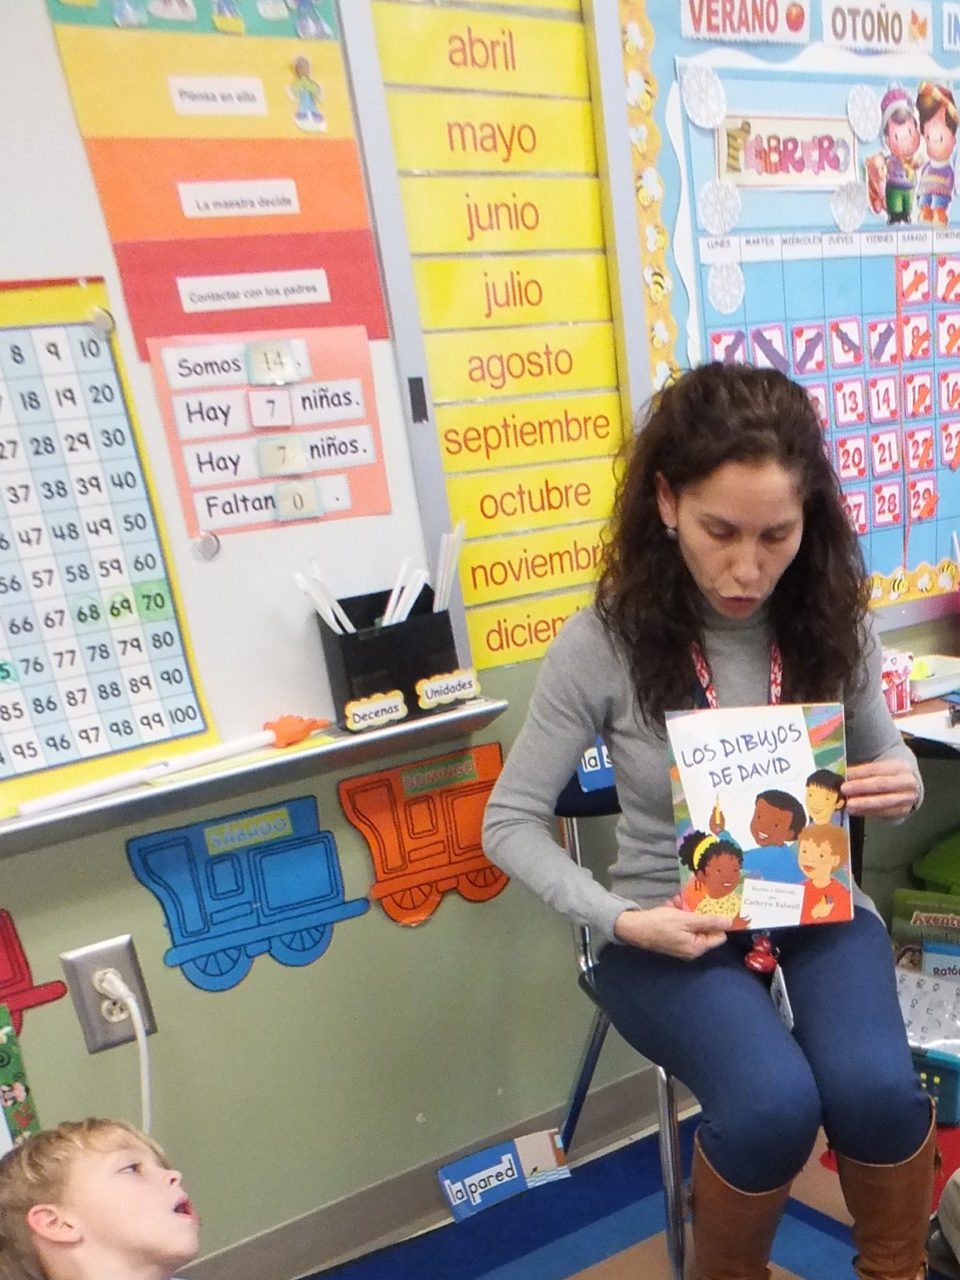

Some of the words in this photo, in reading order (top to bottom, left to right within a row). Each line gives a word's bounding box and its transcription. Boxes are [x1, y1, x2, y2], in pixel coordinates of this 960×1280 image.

[690, 0, 780, 34] VERANO
[831, 3, 902, 43] OTOÑO
[448, 26, 516, 71] abril
[447, 122, 537, 162] mayo
[196, 200, 210, 210] La
[212, 198, 255, 210] maestra
[258, 196, 292, 208] decide
[465, 193, 540, 241] junio
[707, 240, 732, 250] LUNES
[746, 238, 774, 246] MARTES
[866, 233, 894, 244] VIERNES
[189, 290, 240, 303] Contactar
[244, 289, 262, 299] con
[266, 286, 280, 297] los
[284, 284, 318, 298] padres
[484, 270, 544, 318] julio
[11, 344, 24, 364] 8
[46, 342, 62, 361] 9
[80, 339, 100, 358] 10
[178, 358, 242, 378] Somos
[264, 351, 284, 371] 14
[468, 344, 573, 389] agosto
[20, 390, 40, 411] 18
[56, 388, 78, 408] 19
[88, 384, 114, 404] 20
[186, 401, 230, 426] Hay
[266, 400, 276, 418] 7
[301, 387, 360, 412] niñas.
[842, 390, 859, 414] 13
[876, 388, 891, 410] 14
[30, 436, 55, 456] 28
[64, 432, 91, 452] 29
[101, 428, 126, 448] 30
[444, 410, 610, 460] septiembre
[196, 451, 240, 476] Hay
[276, 445, 286, 464] 7
[309, 436, 367, 460] niños.
[841, 448, 862, 470] 20
[878, 441, 893, 464] 21
[7, 484, 30, 504] 37
[41, 480, 68, 500] 38
[76, 476, 102, 495] 39
[110, 471, 137, 489] 40
[206, 494, 276, 518] Faltan
[480, 480, 591, 519] octubre
[878, 494, 896, 514] 28
[18, 528, 42, 546] 47
[52, 522, 80, 541] 48
[86, 518, 113, 536] 49
[123, 513, 146, 532] 50
[32, 569, 54, 588] 57
[65, 564, 90, 583] 58
[99, 559, 124, 578] 59
[134, 553, 157, 572] 60
[470, 540, 602, 590] noviembr
[8, 616, 34, 635] 66
[44, 610, 66, 628] 67
[77, 604, 100, 622] 68
[110, 599, 134, 617] 69
[142, 593, 166, 612] 70
[485, 606, 580, 652] diciem
[19, 657, 44, 676] 76
[53, 649, 77, 668] 77
[86, 644, 110, 662] 78
[118, 638, 142, 656] 79
[152, 631, 174, 649] 80
[0, 702, 24, 721] 85
[32, 696, 58, 714] 86
[66, 688, 88, 707] 87
[98, 682, 122, 700] 88
[129, 675, 152, 694] 89
[160, 668, 184, 686] 90
[352, 704, 400, 723] Decenas
[425, 680, 473, 700] Unidades
[13, 741, 38, 759] 95
[46, 734, 71, 752] 96
[78, 726, 100, 744] 97
[109, 720, 134, 736] 98
[140, 712, 164, 730] 99
[169, 705, 198, 724] 100
[682, 744, 716, 768] LOS
[720, 724, 801, 758] DIBUJOS
[583, 752, 598, 770] la
[709, 767, 732, 788] DE
[737, 758, 790, 782] DAVID
[448, 1184, 465, 1203] la
[468, 1158, 515, 1203] pared
